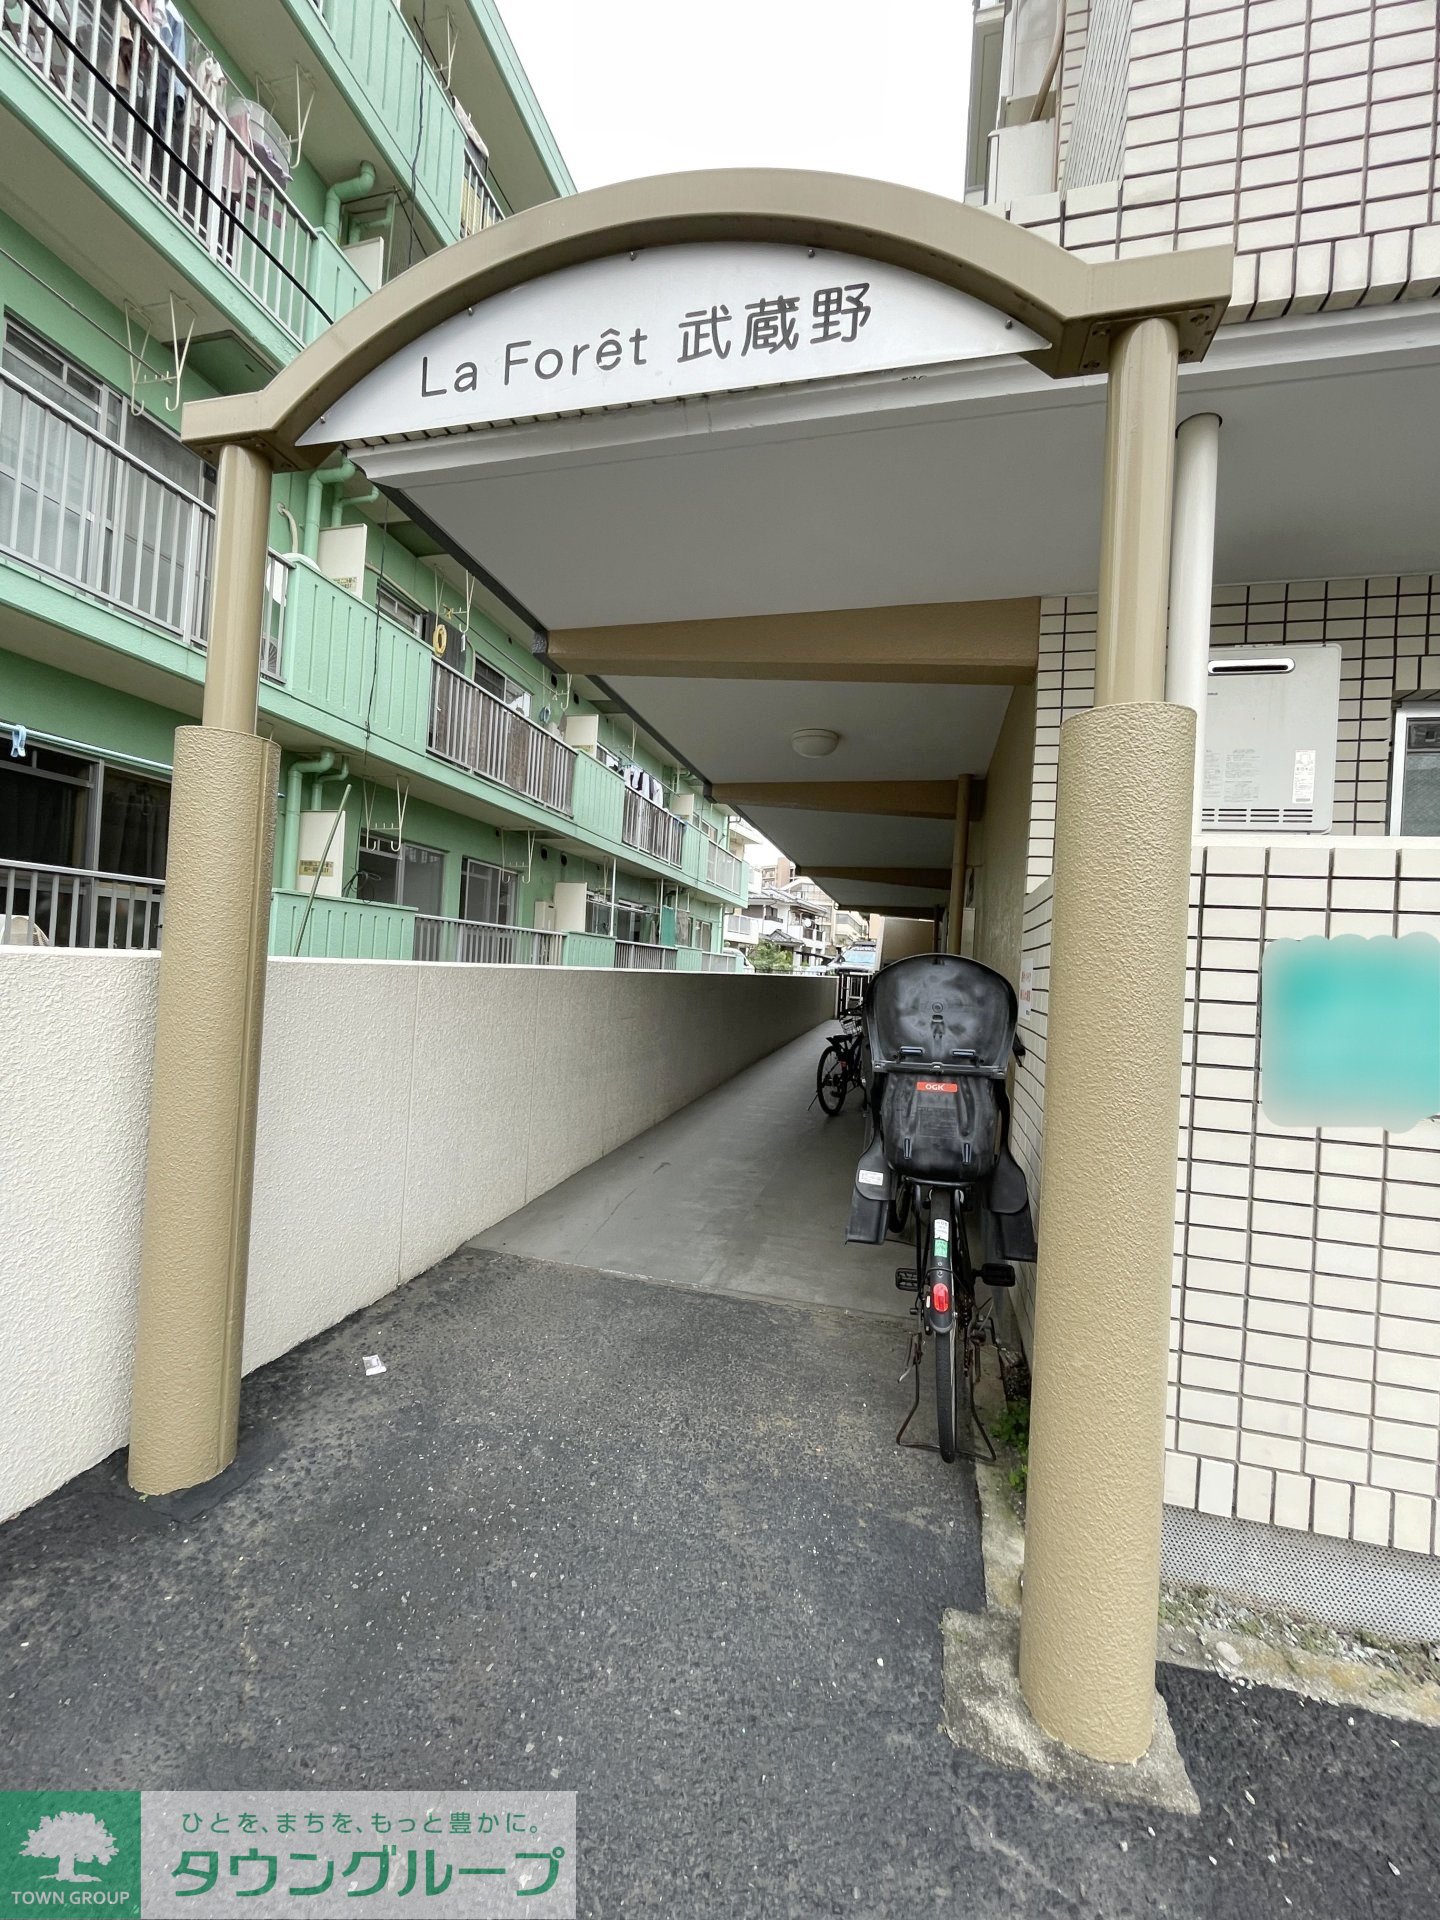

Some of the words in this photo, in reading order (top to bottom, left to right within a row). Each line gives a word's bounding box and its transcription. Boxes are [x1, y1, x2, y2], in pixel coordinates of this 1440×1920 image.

[421, 356, 478, 398] La
[503, 328, 648, 386] Forêt
[677, 282, 872, 363] 武蔵野
[925, 1083, 945, 1091] OGK
